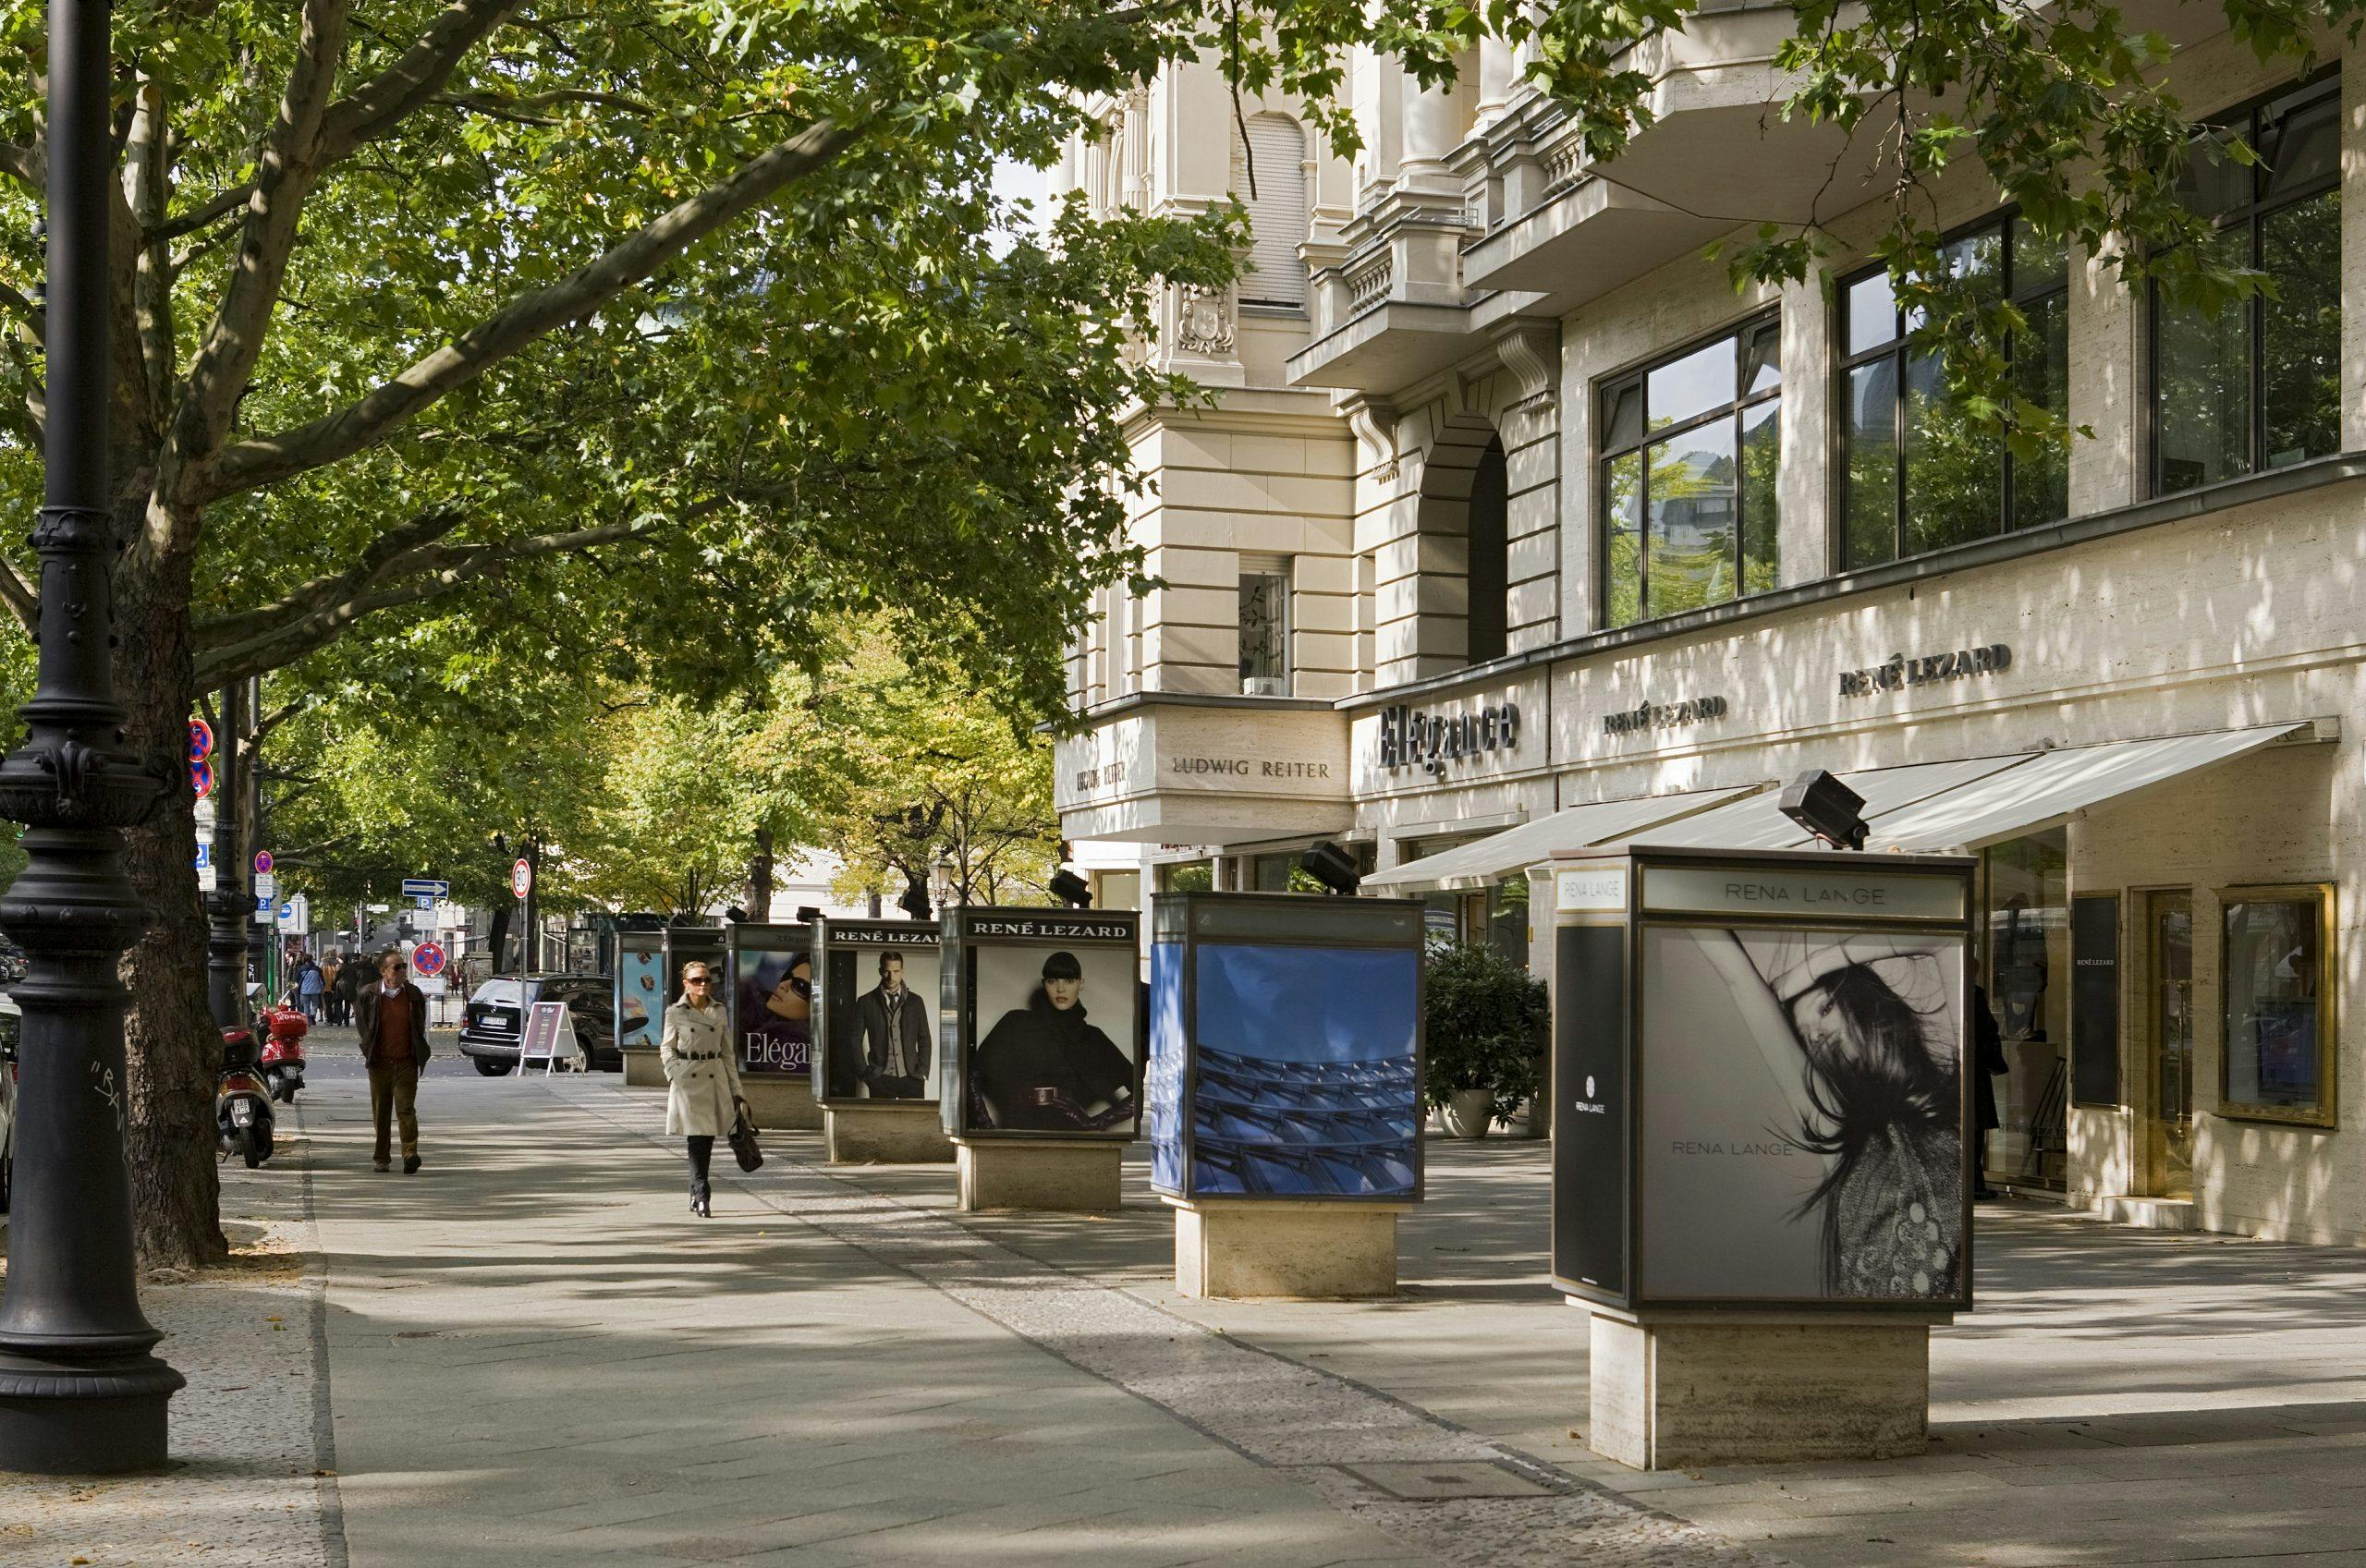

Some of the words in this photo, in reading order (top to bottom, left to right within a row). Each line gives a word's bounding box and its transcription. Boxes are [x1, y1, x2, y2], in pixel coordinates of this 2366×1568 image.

[1838, 652, 1904, 696] RENÉ
[1906, 643, 2011, 686] LEZARD
[1603, 699, 1651, 735] RENÉ
[1652, 695, 1728, 727] LEZARD
[1077, 768, 1101, 792] LUDWIG
[1104, 761, 1127, 785] REITER
[1174, 757, 1250, 775] LUDWIG
[1262, 760, 1331, 779] REITER
[516, 870, 526, 887] 30
[1564, 881, 1588, 898] RENA
[1590, 880, 1620, 898] LANGE
[1725, 883, 1790, 902] RENA
[1803, 886, 1886, 906] LANGE
[835, 930, 883, 942] RENÉ
[973, 921, 1034, 935] RENÉ
[1040, 925, 1127, 938] LEZARD
[1575, 1101, 1589, 1112] RENA
[1589, 1103, 1605, 1114] LANGE
[1672, 1141, 1723, 1156] RENA
[1731, 1142, 1794, 1157] LANGE
